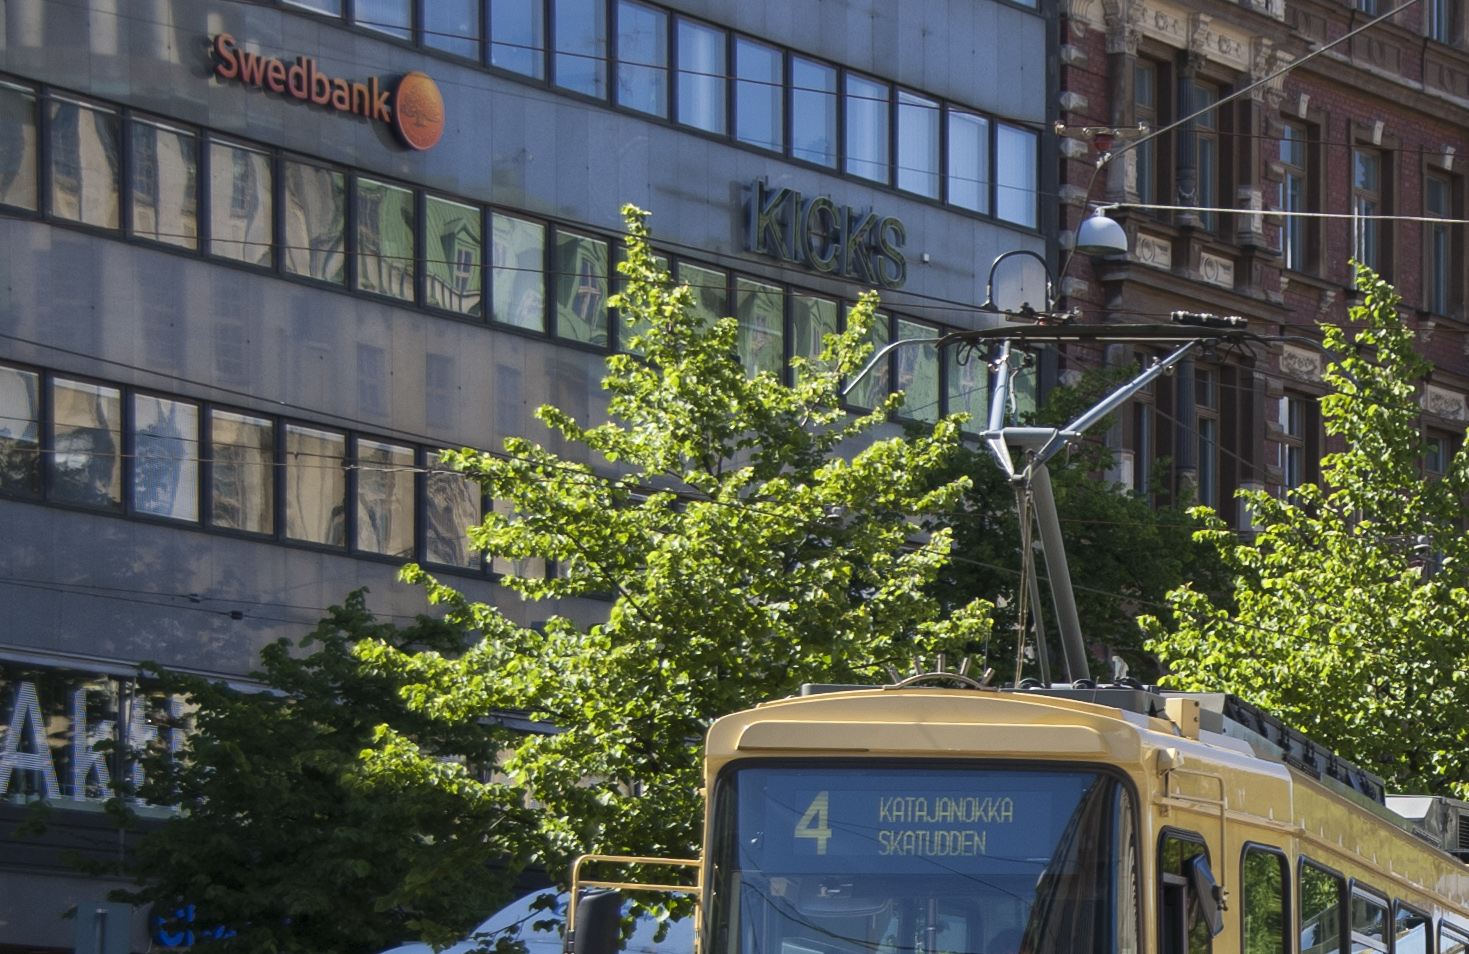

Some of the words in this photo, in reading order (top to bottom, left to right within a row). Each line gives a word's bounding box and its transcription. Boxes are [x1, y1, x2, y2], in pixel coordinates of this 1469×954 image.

[213, 33, 391, 122] Swedbank
[752, 176, 908, 290] KICKS
[0, 681, 188, 808] Akti
[794, 790, 833, 855] 4
[878, 830, 987, 856] SKATUDDEN
[879, 797, 1014, 823] KATAJANOKKA
